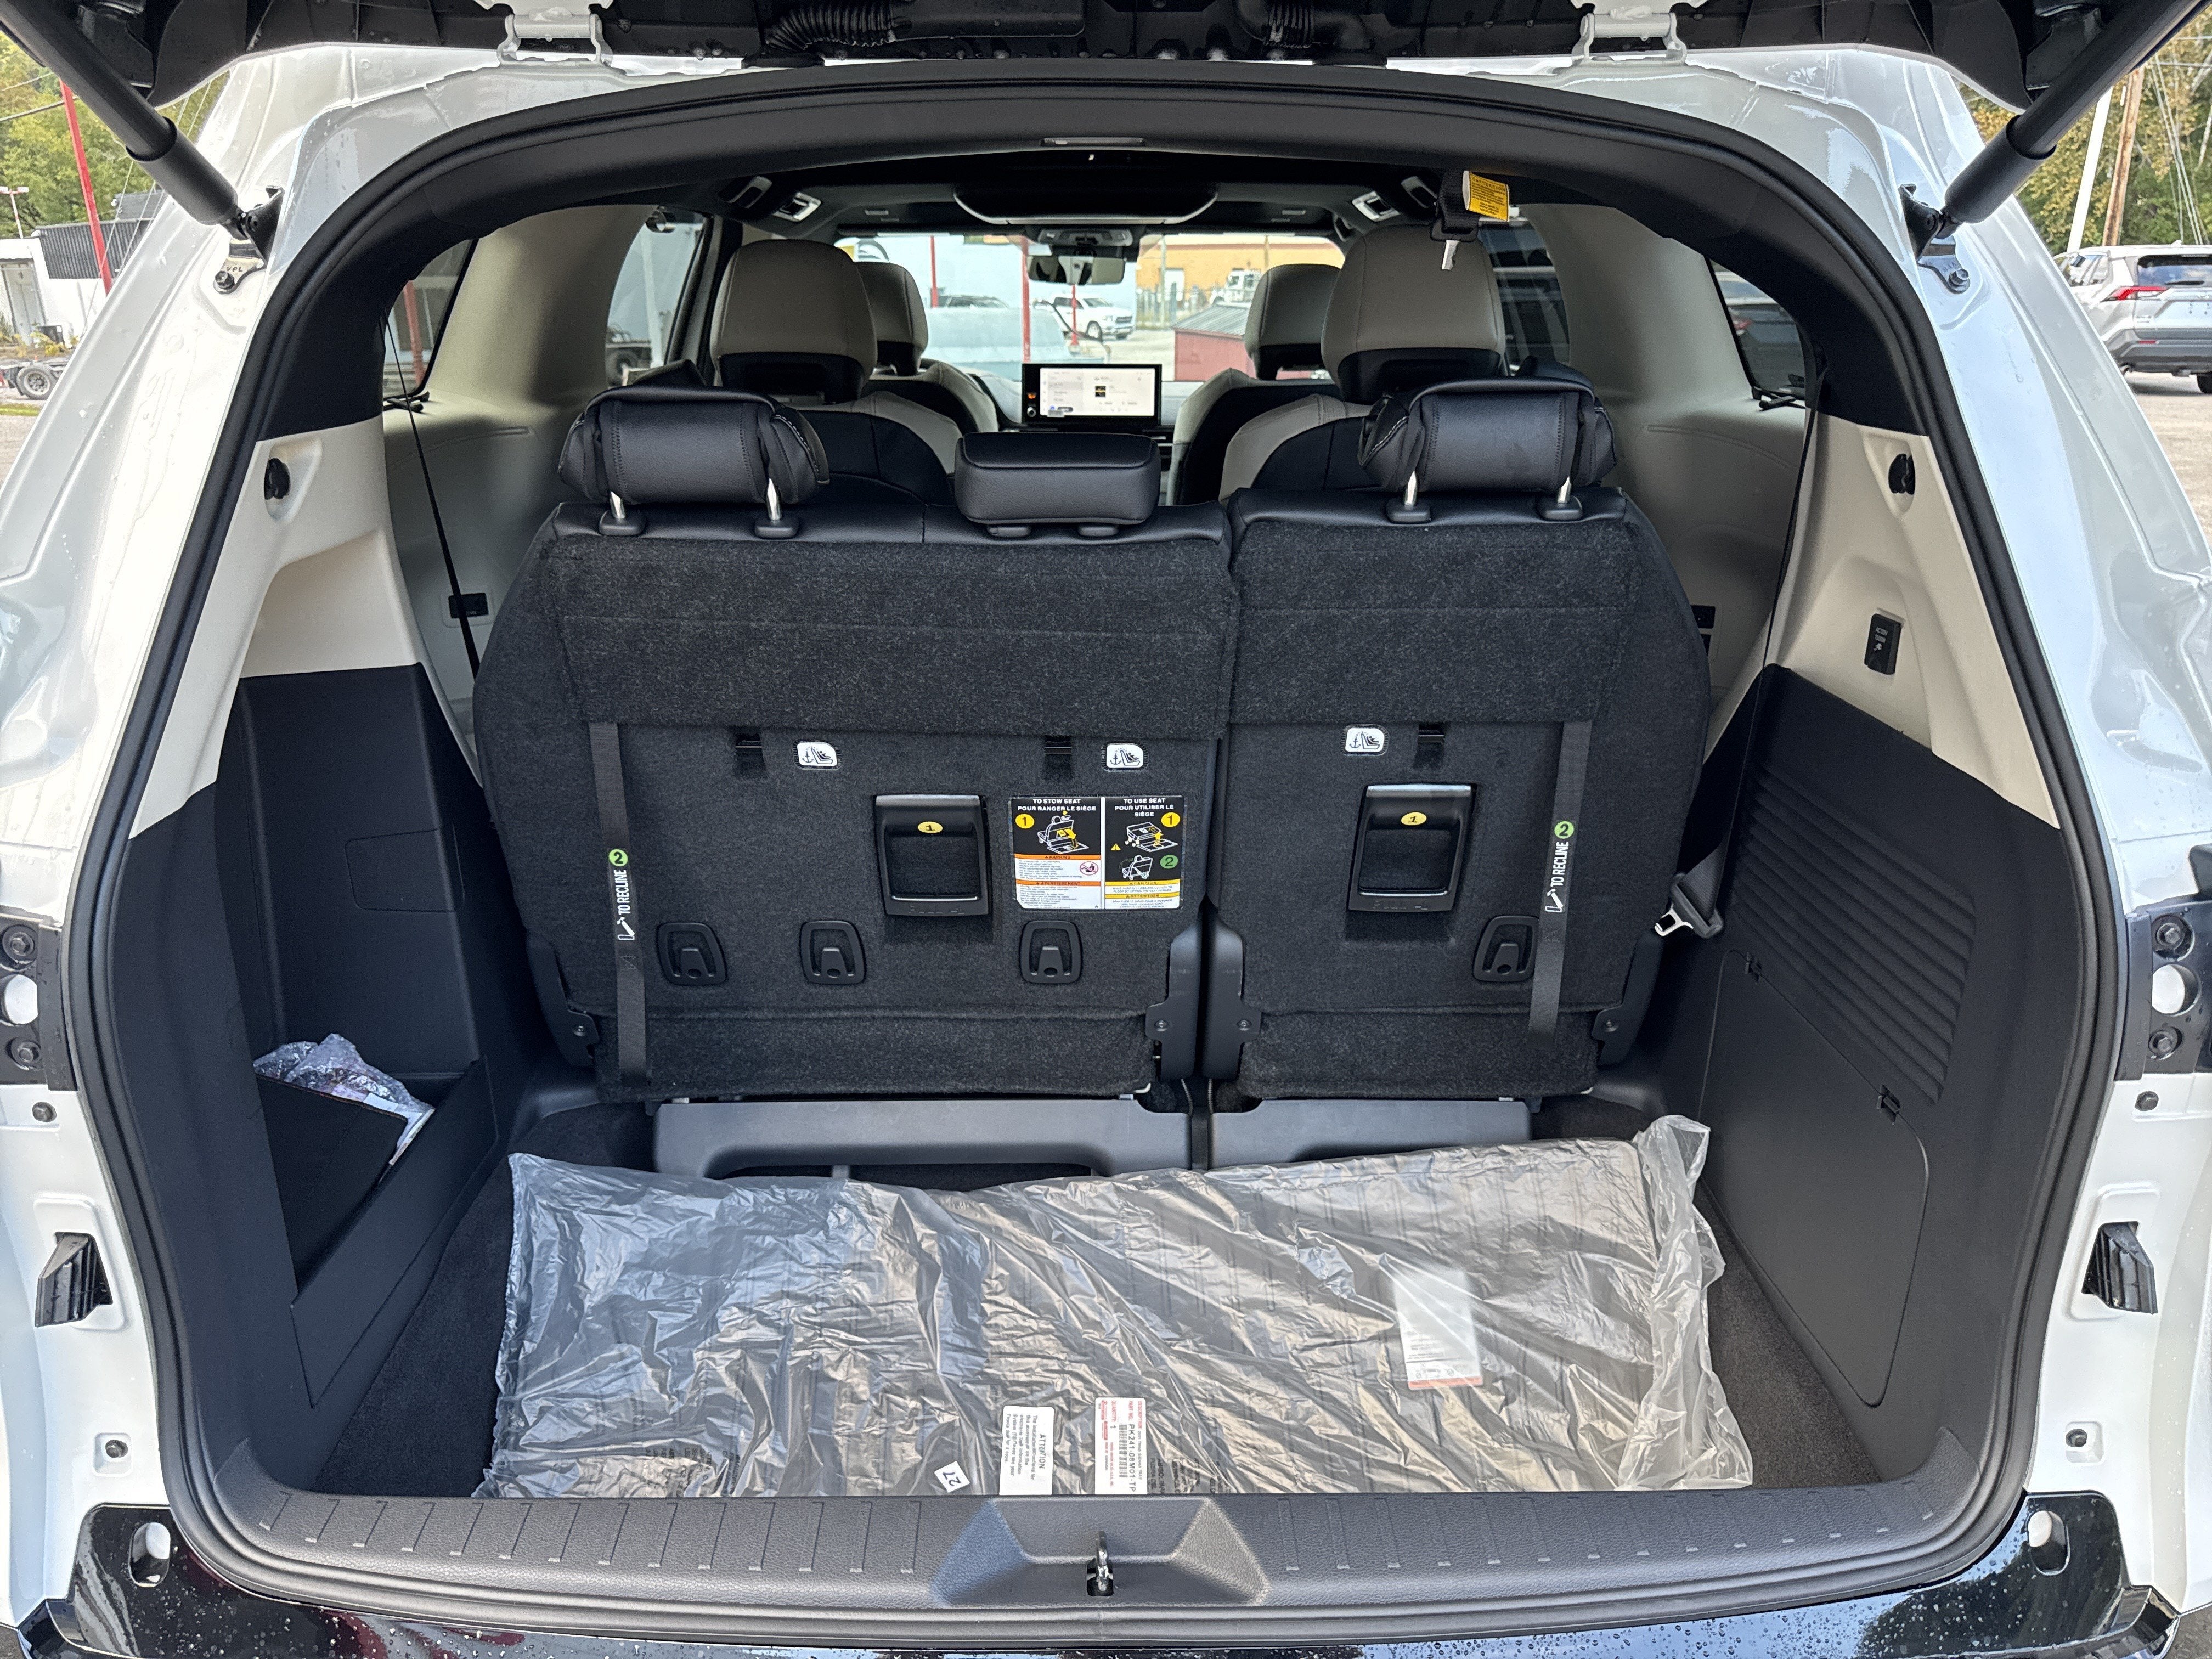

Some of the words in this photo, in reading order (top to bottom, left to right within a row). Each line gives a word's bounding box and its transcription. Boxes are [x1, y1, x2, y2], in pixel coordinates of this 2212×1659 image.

[1021, 817, 1026, 826] 1
[1167, 815, 1172, 825] 1
[1559, 823, 1569, 837] 2
[613, 851, 624, 864] 2
[1165, 856, 1173, 866] 2
[1552, 842, 1569, 875] RECLINE
[613, 869, 630, 903] RECLINE
[1550, 876, 1564, 887] TO
[617, 904, 631, 915] TO
